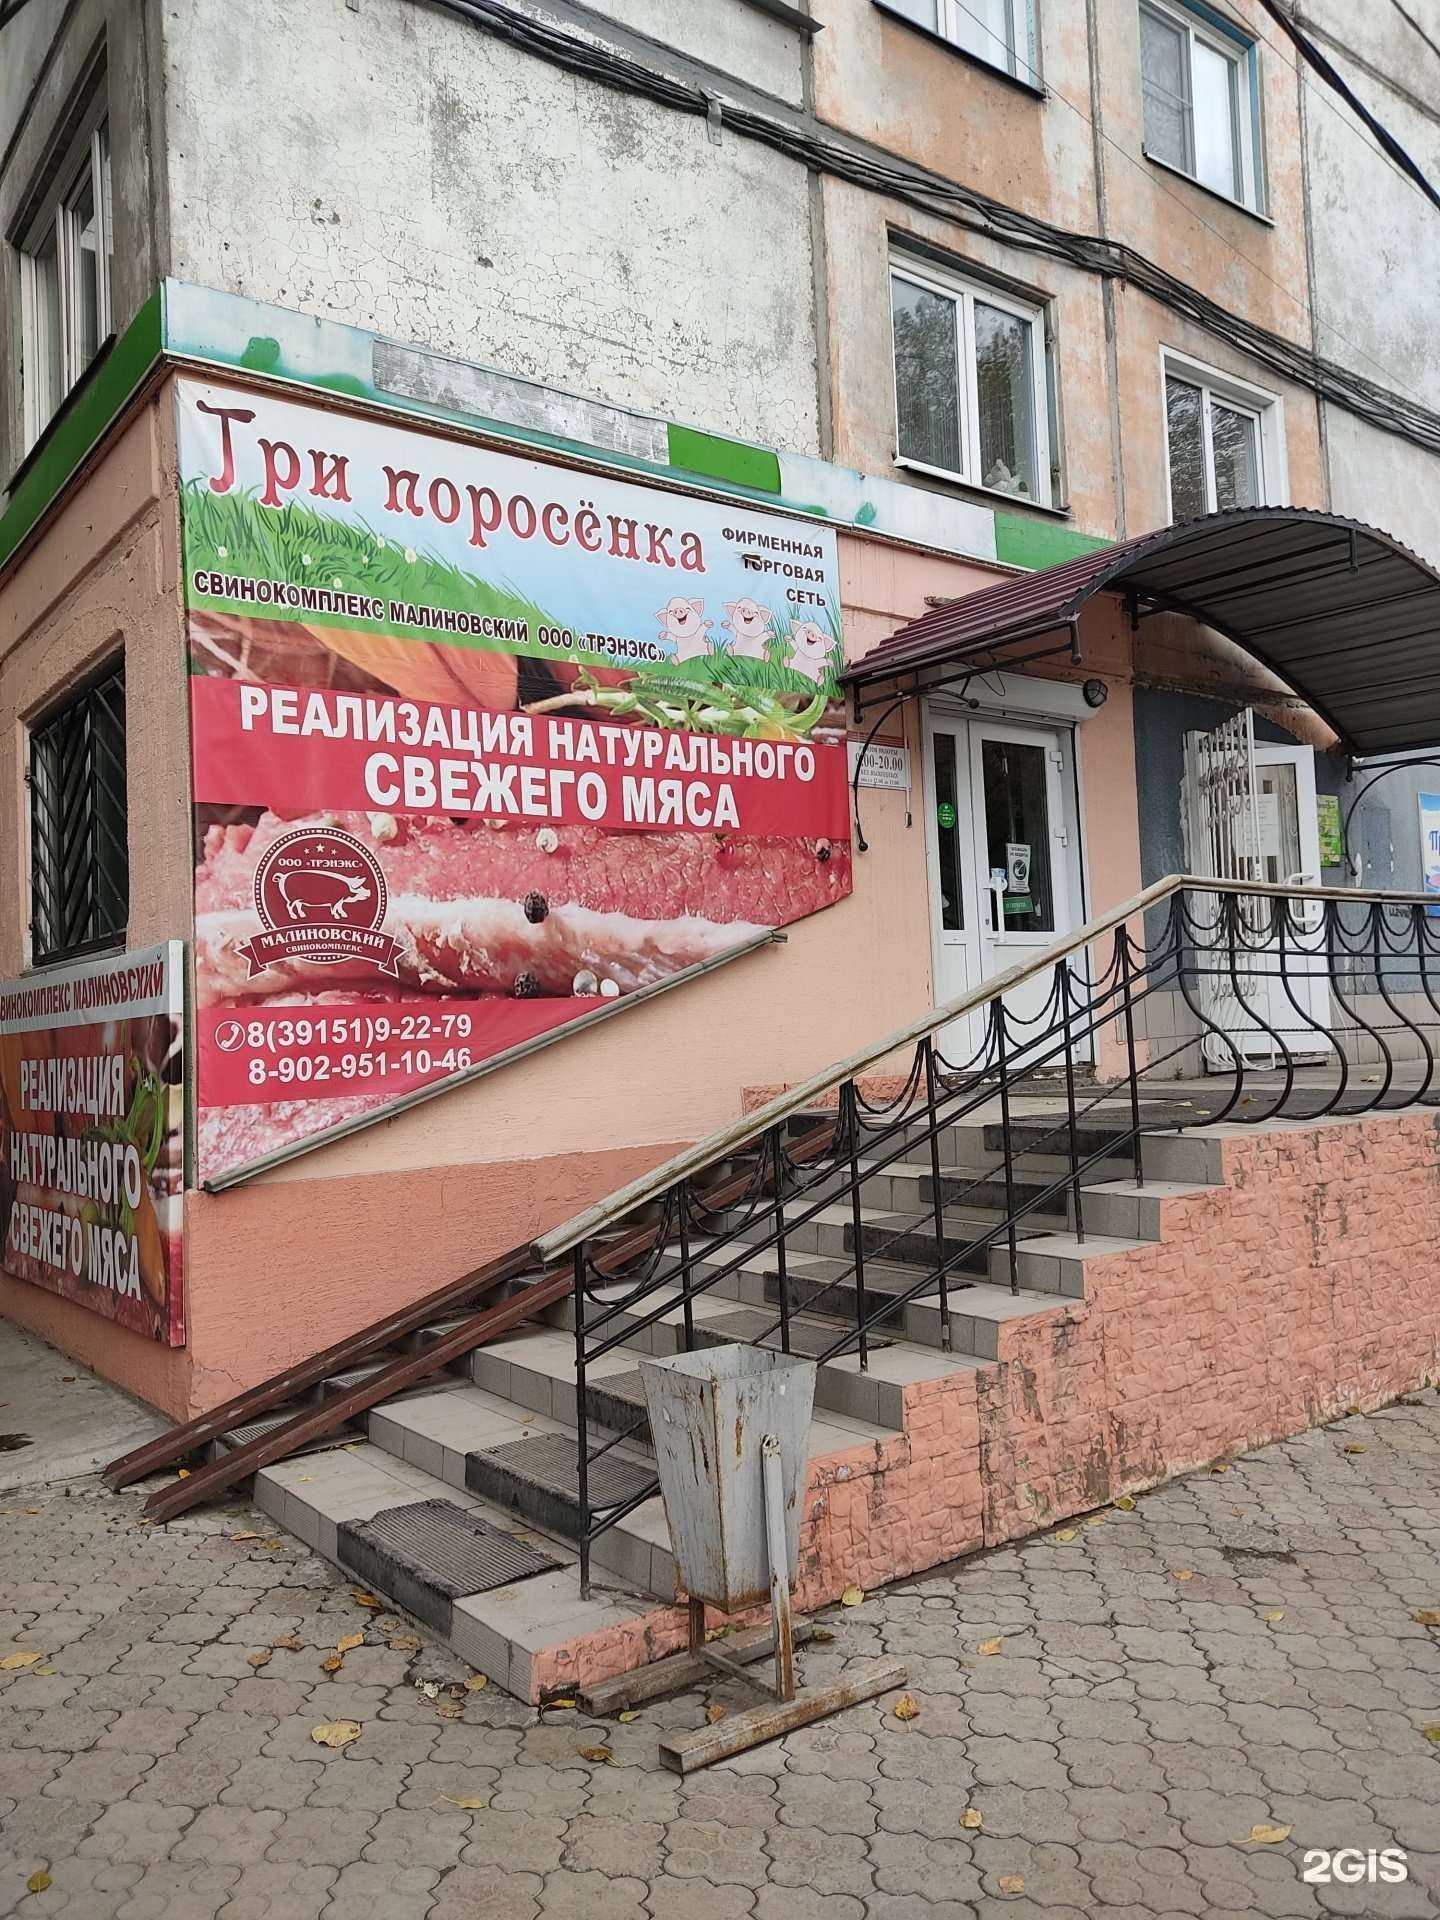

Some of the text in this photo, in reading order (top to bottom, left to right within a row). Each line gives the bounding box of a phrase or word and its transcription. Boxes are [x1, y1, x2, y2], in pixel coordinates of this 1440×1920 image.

[196, 400, 706, 573] Три поросёнка
[722, 527, 824, 560] ФИРМЕННАЯ
[194, 570, 666, 662] СВИНОКОМПЛЕКС МАЛИНОВСКИЙ ООО «ТРЭНЭКС»
[786, 588, 826, 607] СЕТЬ
[240, 686, 815, 782] РЕАЛИЗАЦИЯ НАТУРАЛЬНОГО
[364, 752, 741, 828] СВЕЖЕГО МЯСА
[278, 858, 302, 867] ООО
[260, 928, 386, 949] МАЛИНОВСКИЙ
[285, 943, 363, 954] СВИНОКОМПЛЕКС
[0, 953, 164, 1022] ВИНОКОМПЛЕКС МАЛИНОВСКИЙ
[247, 1014, 472, 1053] 8(39151)9-22-79
[248, 1048, 472, 1085] 8-902-951-10-46
[21, 1055, 125, 1127] РЕАЛИЗАЦИЯ
[11, 1131, 142, 1209] НАТУРАЛЬНОГО
[11, 1201, 142, 1301] СВЕЖЕГО МЯСА
